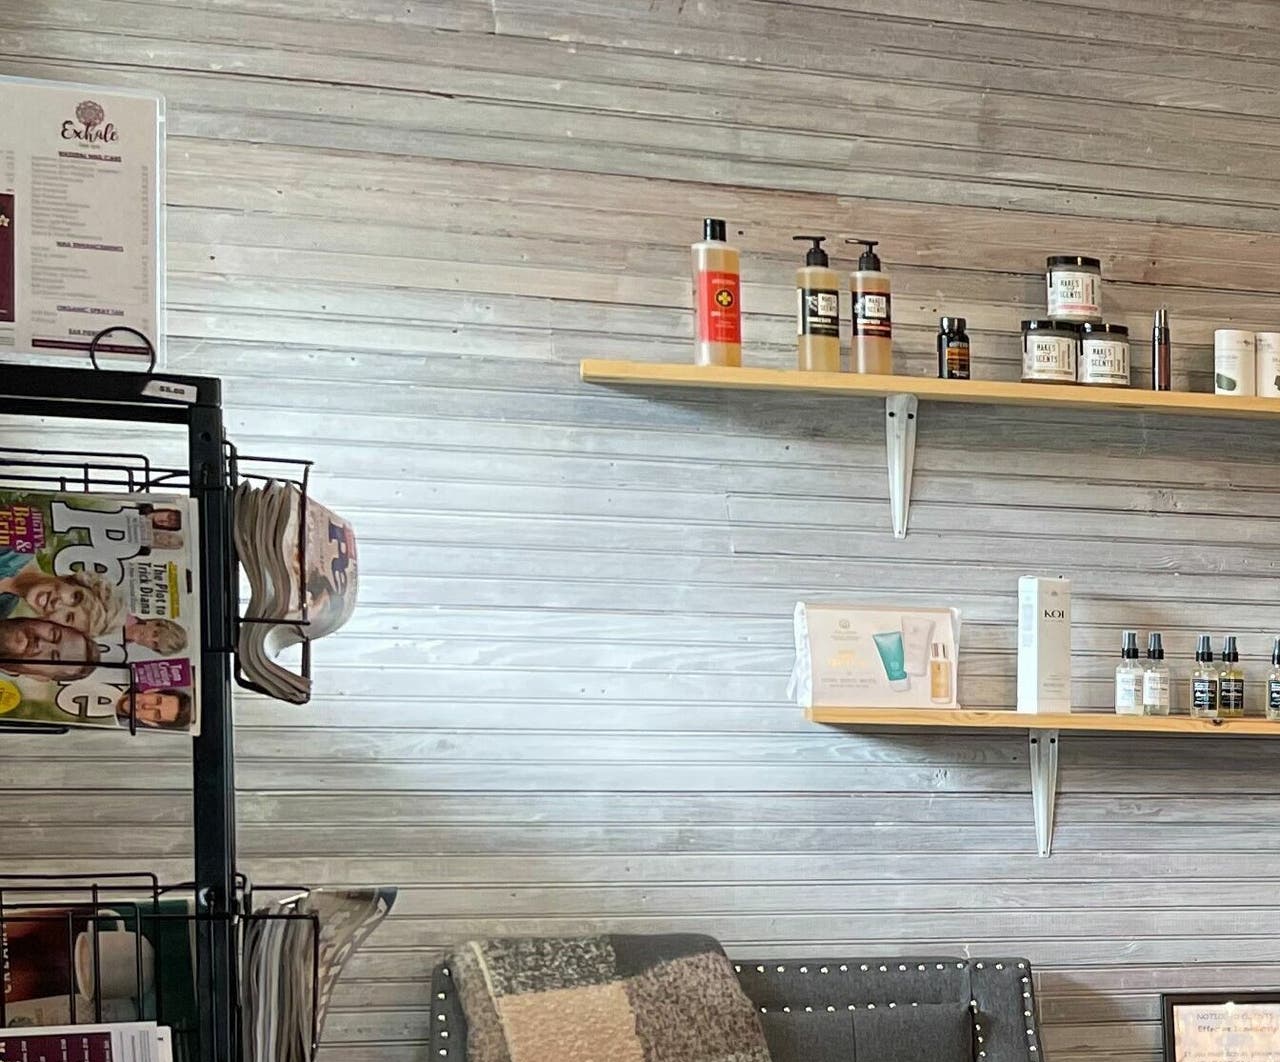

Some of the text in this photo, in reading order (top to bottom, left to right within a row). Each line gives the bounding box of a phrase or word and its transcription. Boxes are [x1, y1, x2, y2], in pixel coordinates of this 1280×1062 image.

[61, 120, 119, 142] Exhale
[14, 507, 30, 536] Ben
[139, 561, 153, 615] Trick Diana
[153, 563, 168, 616] The Plot to
[1044, 609, 1065, 619] KOI
